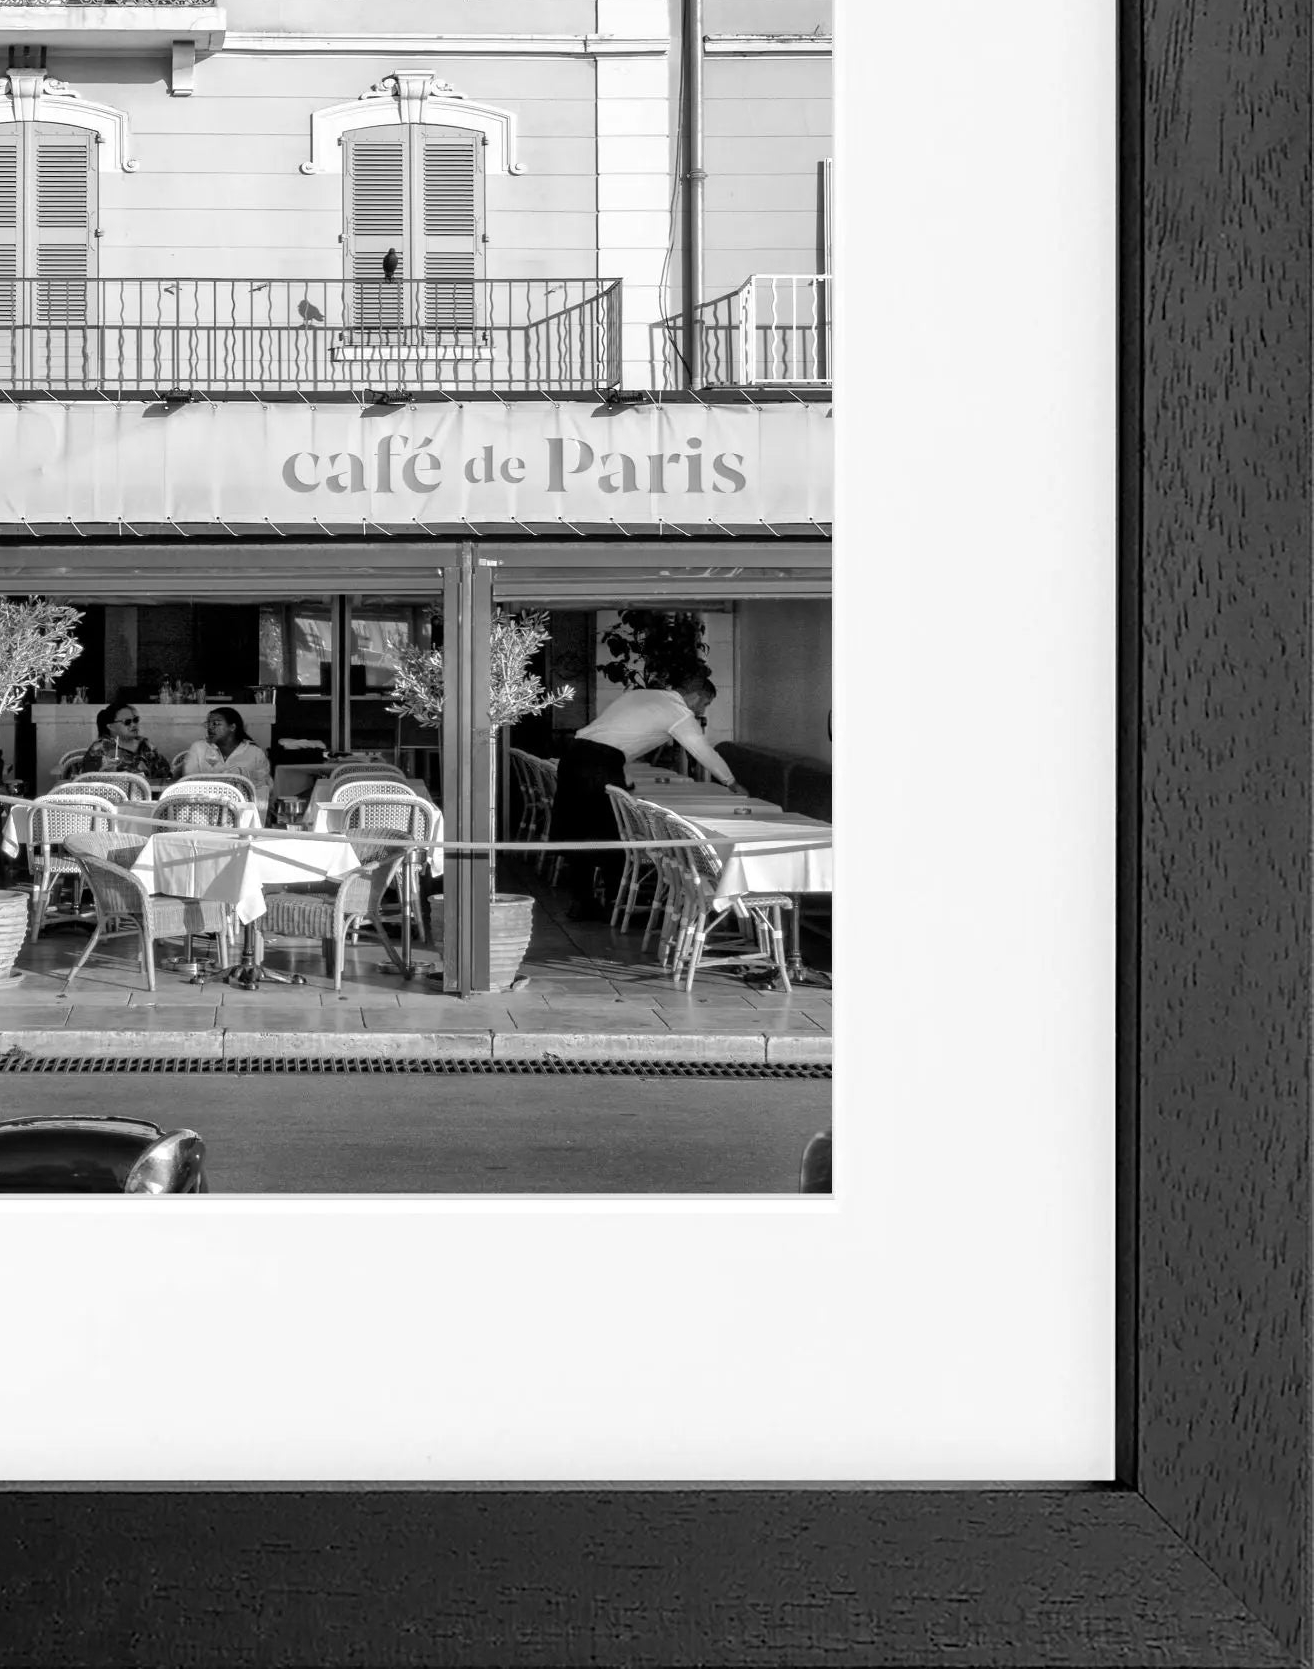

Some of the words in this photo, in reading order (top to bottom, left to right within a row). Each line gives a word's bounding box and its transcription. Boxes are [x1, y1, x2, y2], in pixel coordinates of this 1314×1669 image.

[281, 434, 442, 494] café
[464, 444, 526, 485] de
[546, 437, 747, 494] Paris
